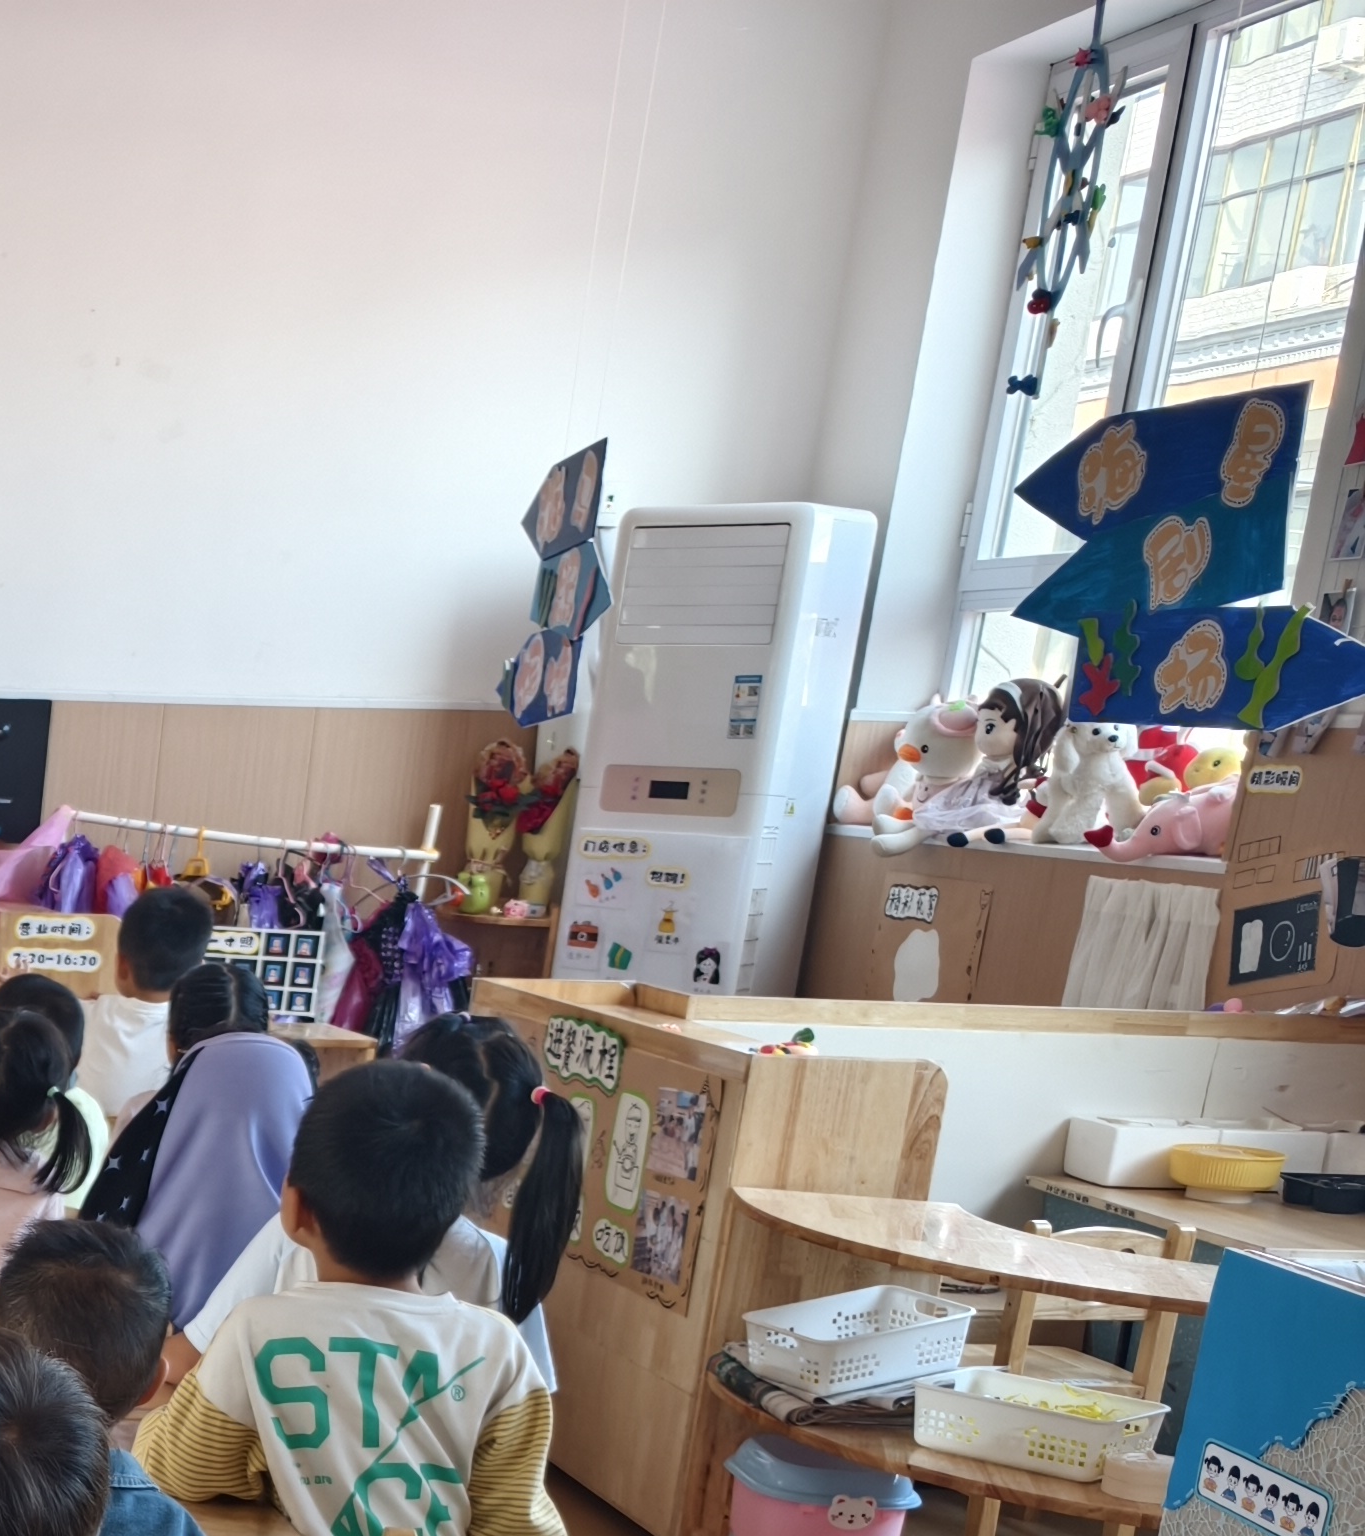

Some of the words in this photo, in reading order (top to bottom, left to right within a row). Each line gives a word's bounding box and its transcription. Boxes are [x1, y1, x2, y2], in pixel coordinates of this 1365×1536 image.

[1156, 629, 1223, 711] 场
[546, 1020, 617, 1081] 进餐流程
